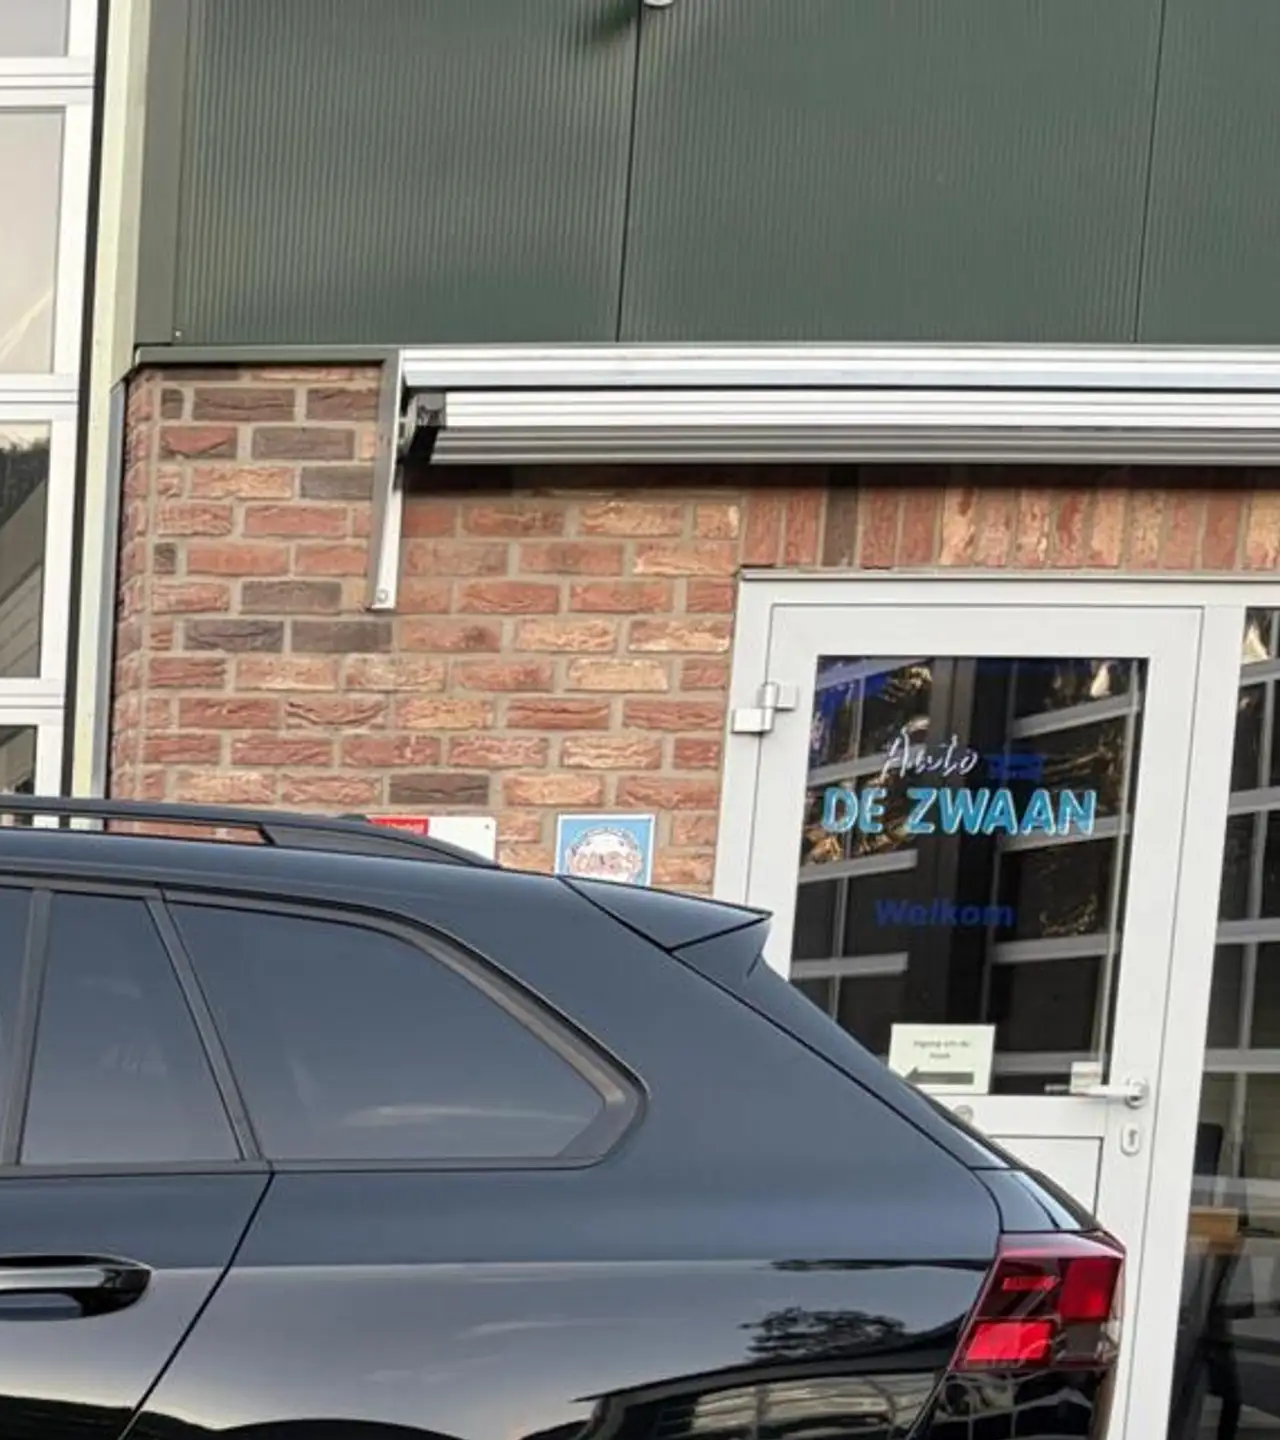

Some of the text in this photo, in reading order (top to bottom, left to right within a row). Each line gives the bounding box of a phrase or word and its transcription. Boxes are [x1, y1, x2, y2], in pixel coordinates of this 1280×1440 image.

[821, 787, 1097, 836] DE ZWAAN
[874, 898, 1015, 929] Welkom
